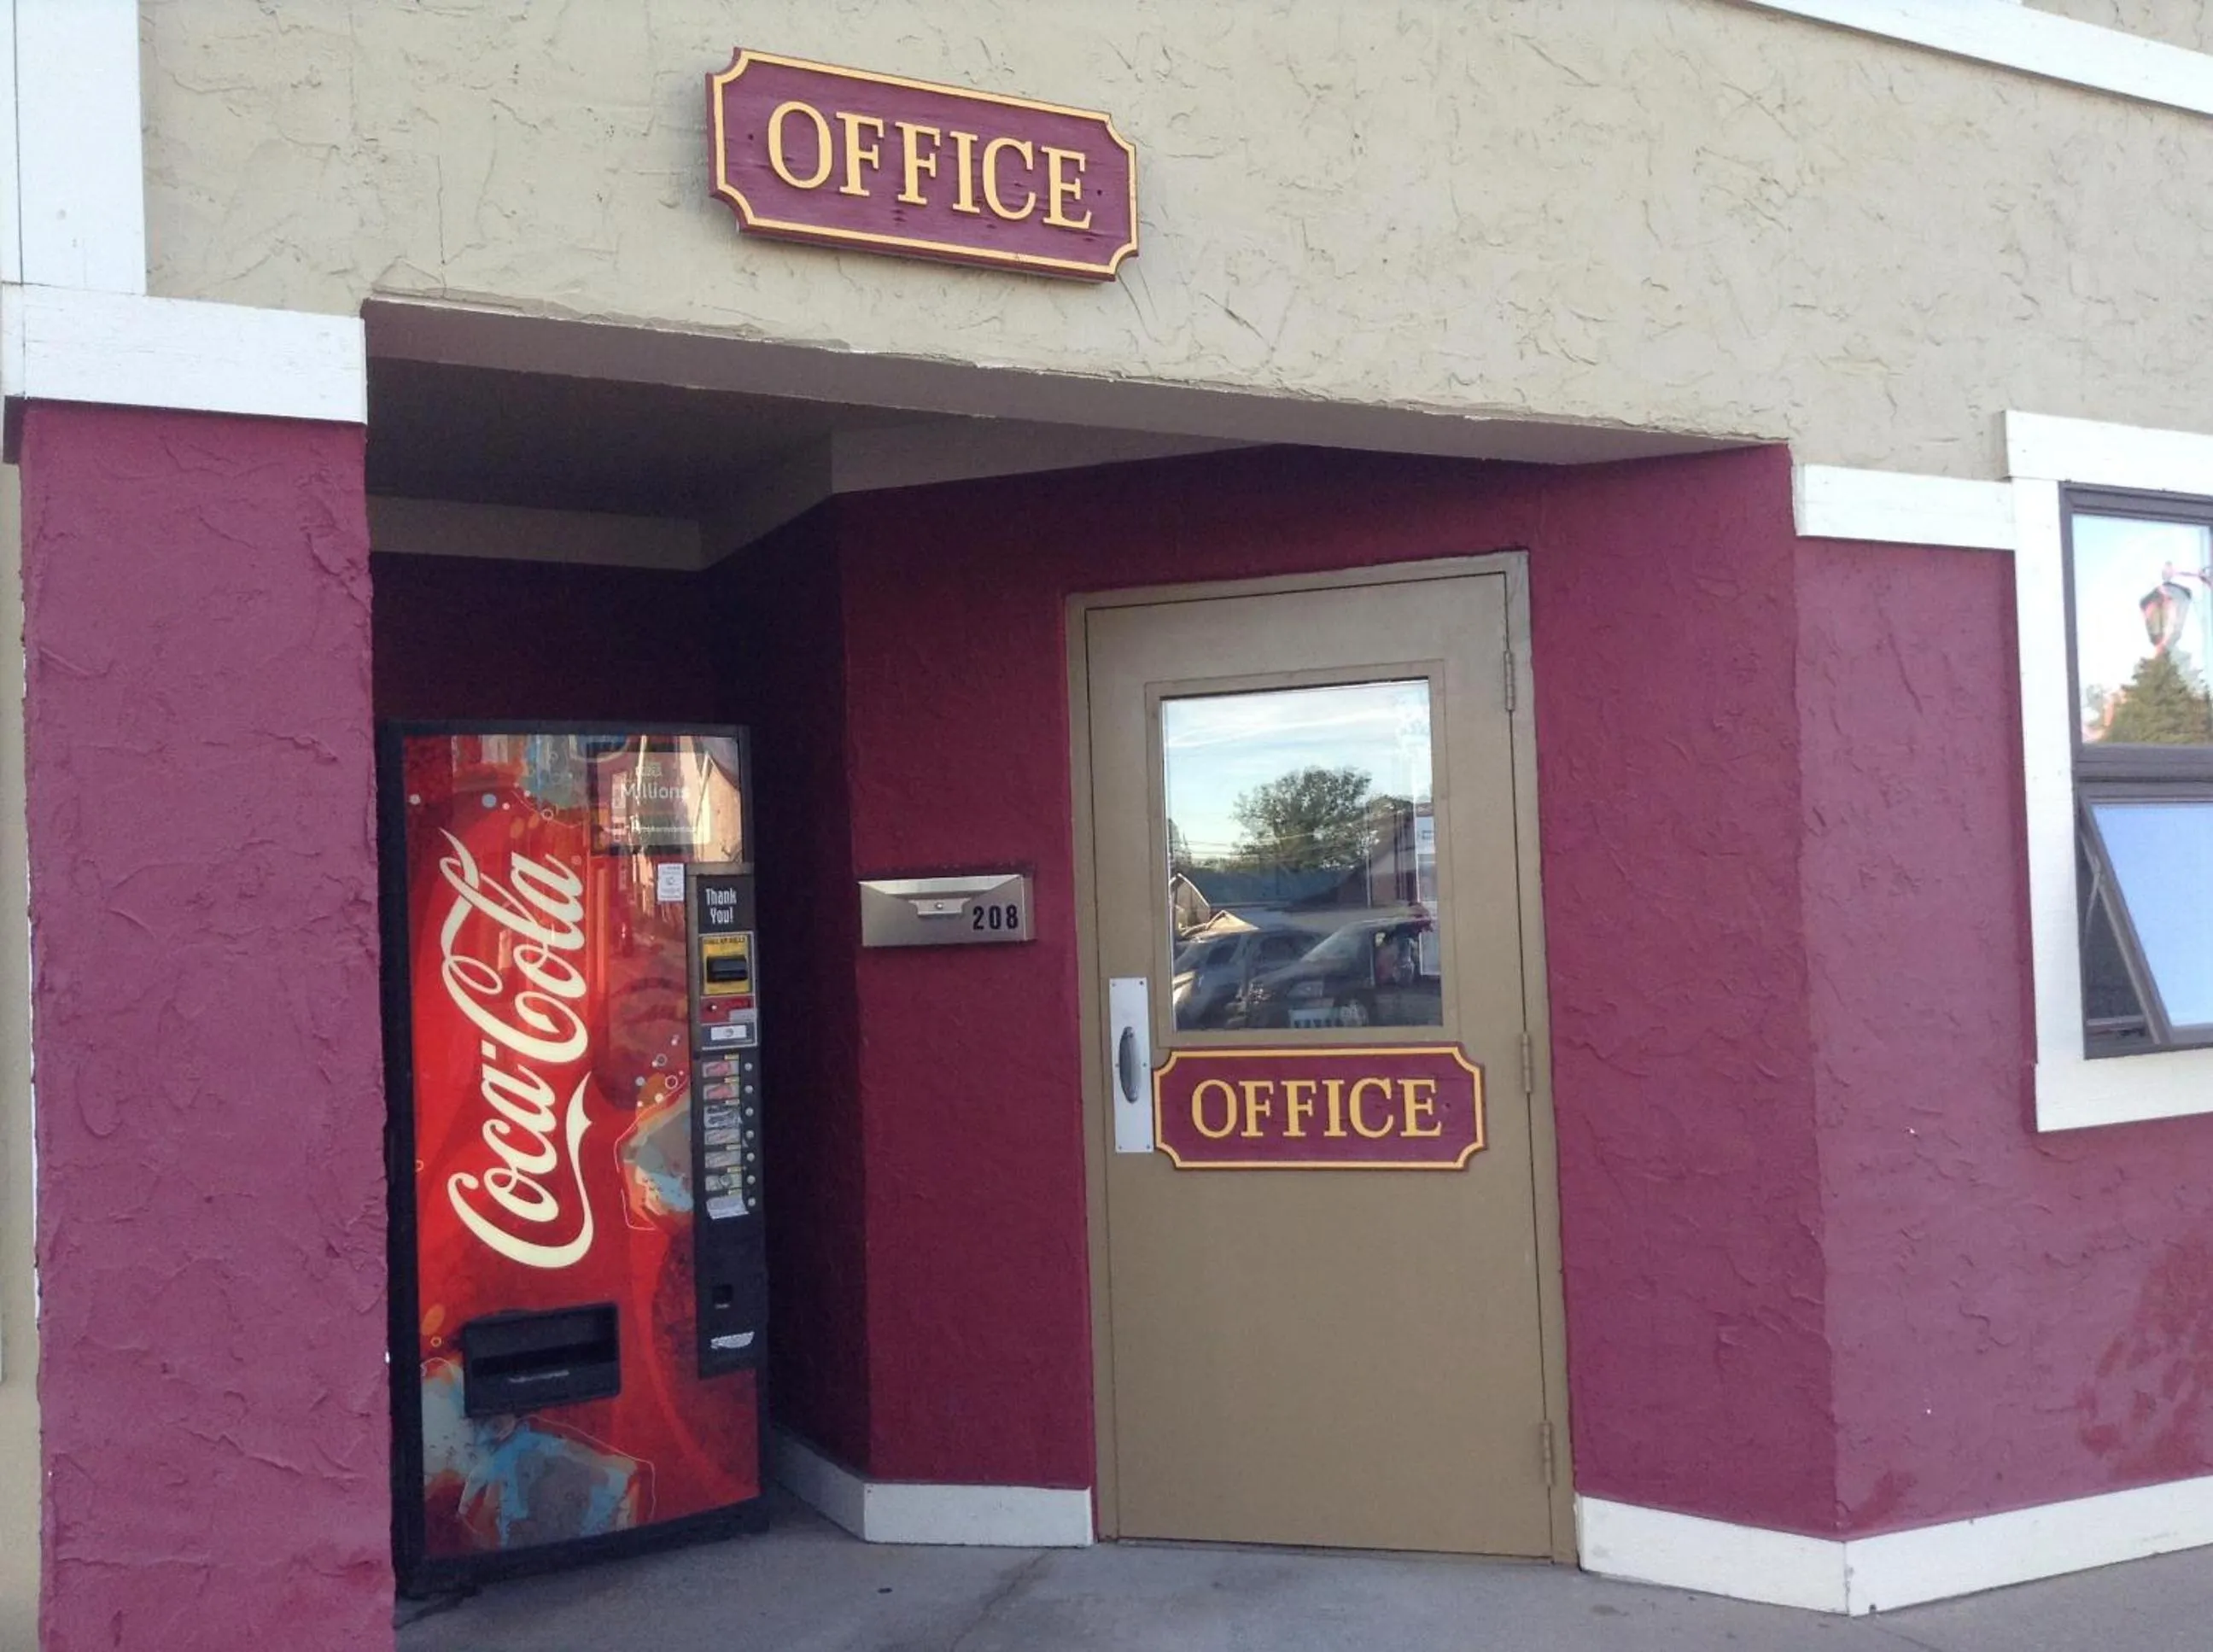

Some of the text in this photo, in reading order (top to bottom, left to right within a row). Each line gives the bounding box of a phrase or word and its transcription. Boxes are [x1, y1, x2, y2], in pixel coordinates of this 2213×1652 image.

[768, 101, 1092, 230] OFFICE
[705, 888, 737, 905] Thank
[710, 907, 733, 924] You!
[972, 905, 1018, 930] 208
[440, 827, 593, 1268] Coca-Cola
[1191, 1077, 1442, 1139] OFFICE
